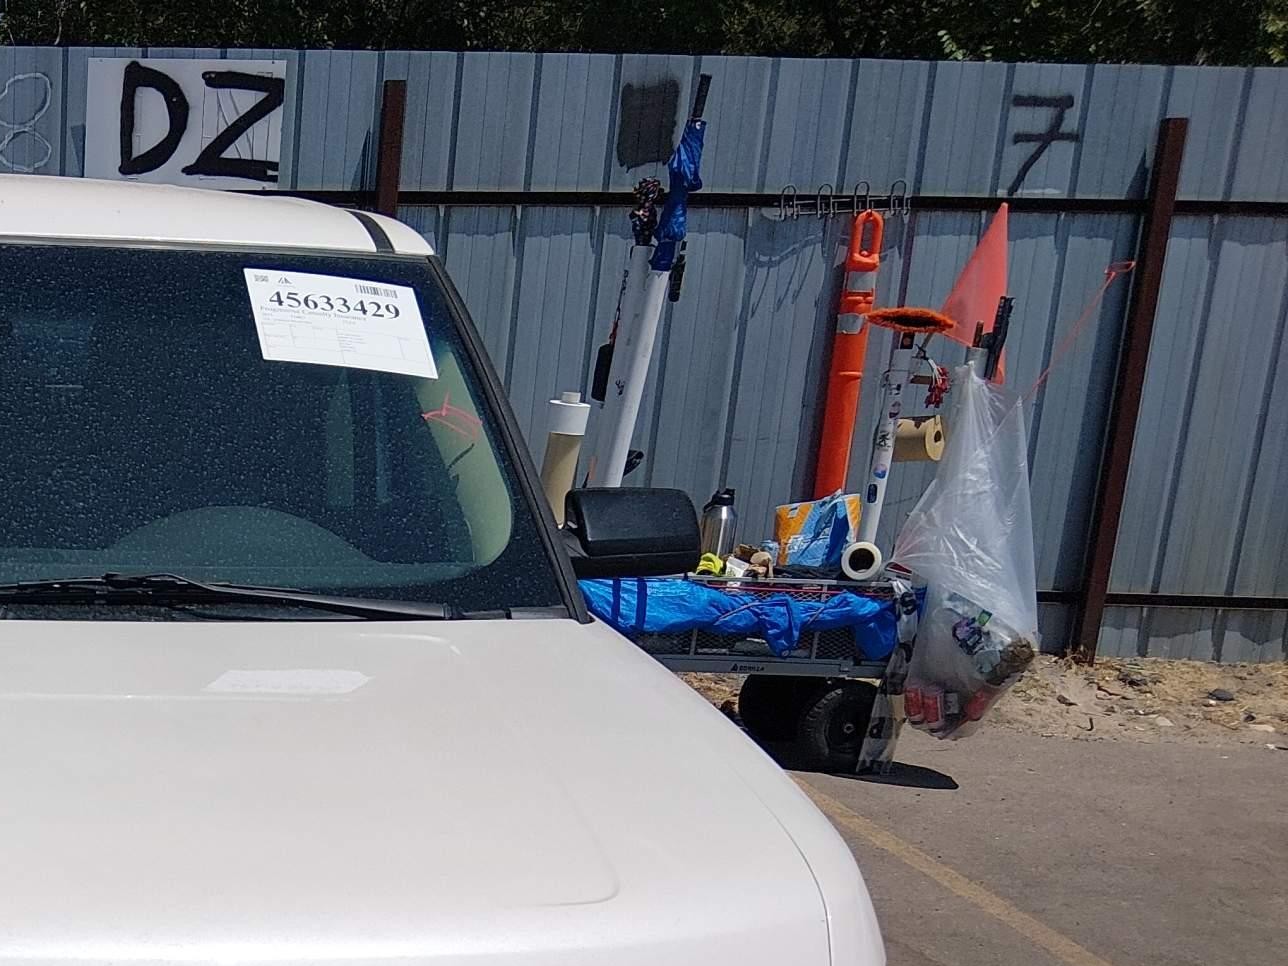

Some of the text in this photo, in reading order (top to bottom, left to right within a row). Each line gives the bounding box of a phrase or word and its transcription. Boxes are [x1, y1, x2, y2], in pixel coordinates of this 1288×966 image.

[118, 60, 286, 183] DZ
[1007, 93, 1081, 197] 7
[268, 289, 401, 320] 45633429
